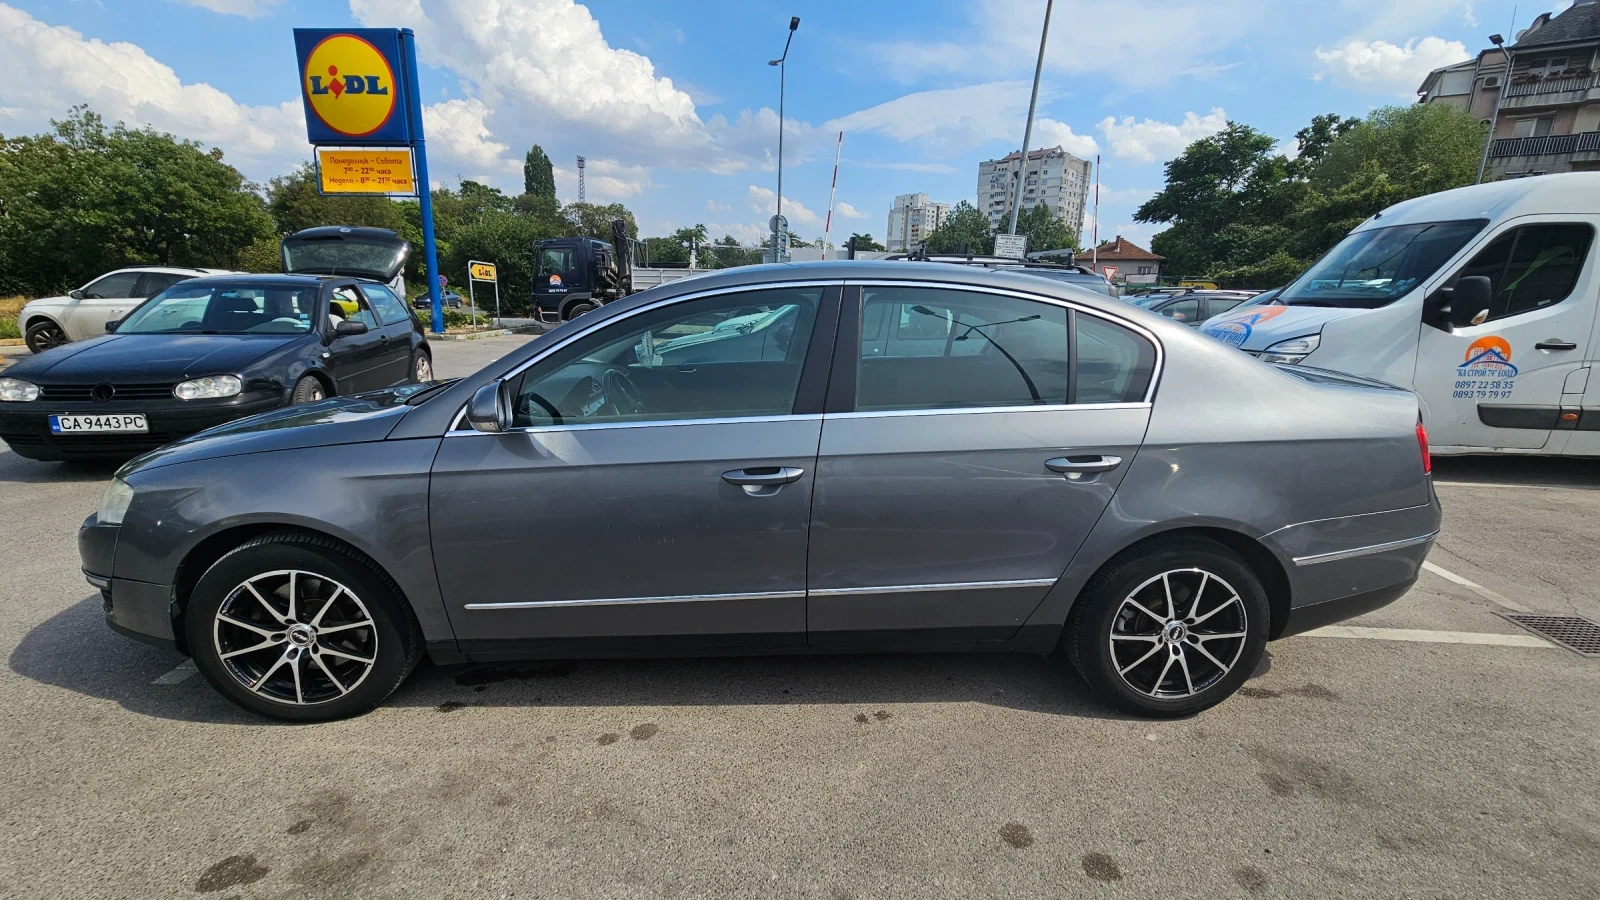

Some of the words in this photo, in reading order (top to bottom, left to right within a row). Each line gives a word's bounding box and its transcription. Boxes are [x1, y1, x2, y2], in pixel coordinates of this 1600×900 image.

[329, 156, 369, 166] Понеделник
[329, 177, 353, 185] Неделя
[1468, 368, 1486, 377] СТРОЙ
[1498, 369, 1514, 378] ЕООД
[1455, 381, 1476, 389] 0897
[1478, 381, 1488, 389] 22
[1490, 381, 1501, 389] 58
[1502, 381, 1514, 389] 35
[1453, 391, 1474, 399] 0893
[1476, 391, 1486, 399] 79
[1488, 391, 1499, 399] 79
[1500, 391, 1512, 399] 97
[61, 417, 82, 430] CA
[84, 417, 121, 430] 9443
[123, 416, 144, 429] PC
